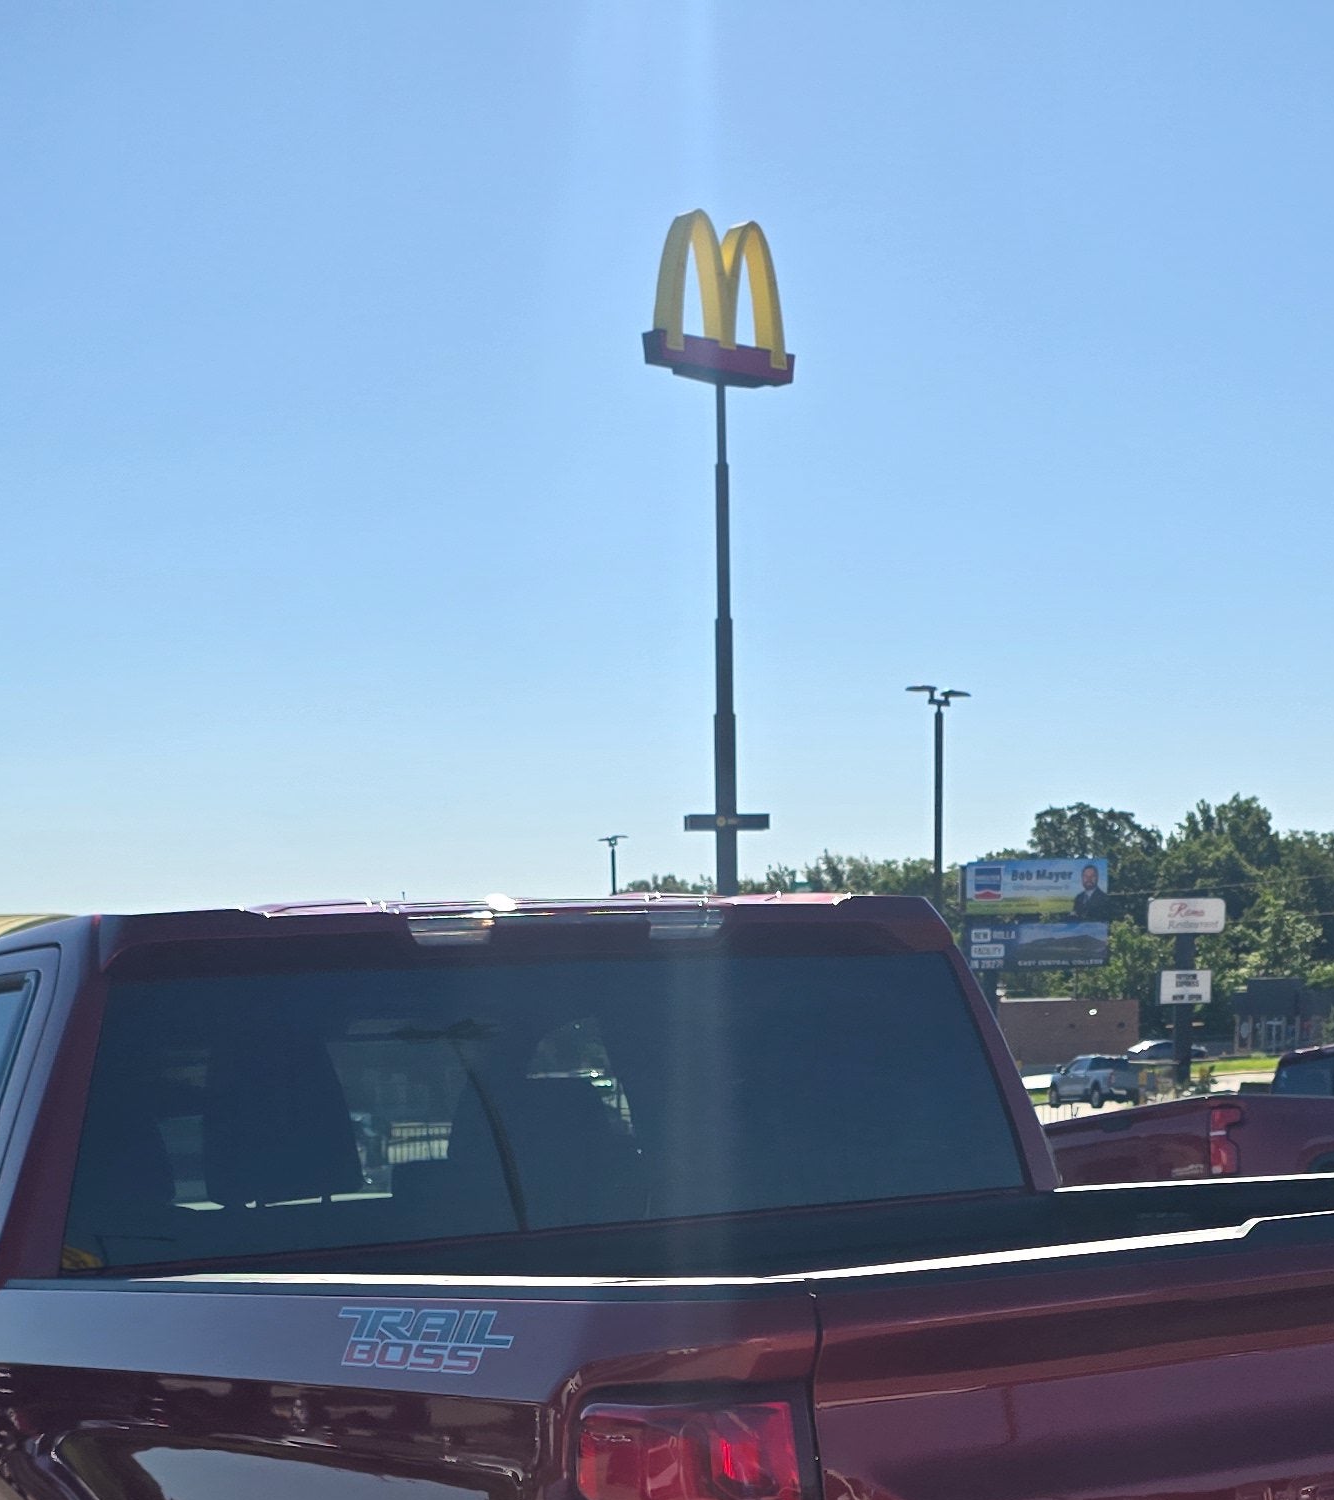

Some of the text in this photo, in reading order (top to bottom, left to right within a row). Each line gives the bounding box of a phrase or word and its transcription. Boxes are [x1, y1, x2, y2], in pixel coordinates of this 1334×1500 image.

[1011, 869, 1033, 881] Bob
[1037, 869, 1074, 883] Mayer
[338, 1306, 515, 1349] TRAIL
[341, 1337, 485, 1375] BOSS
